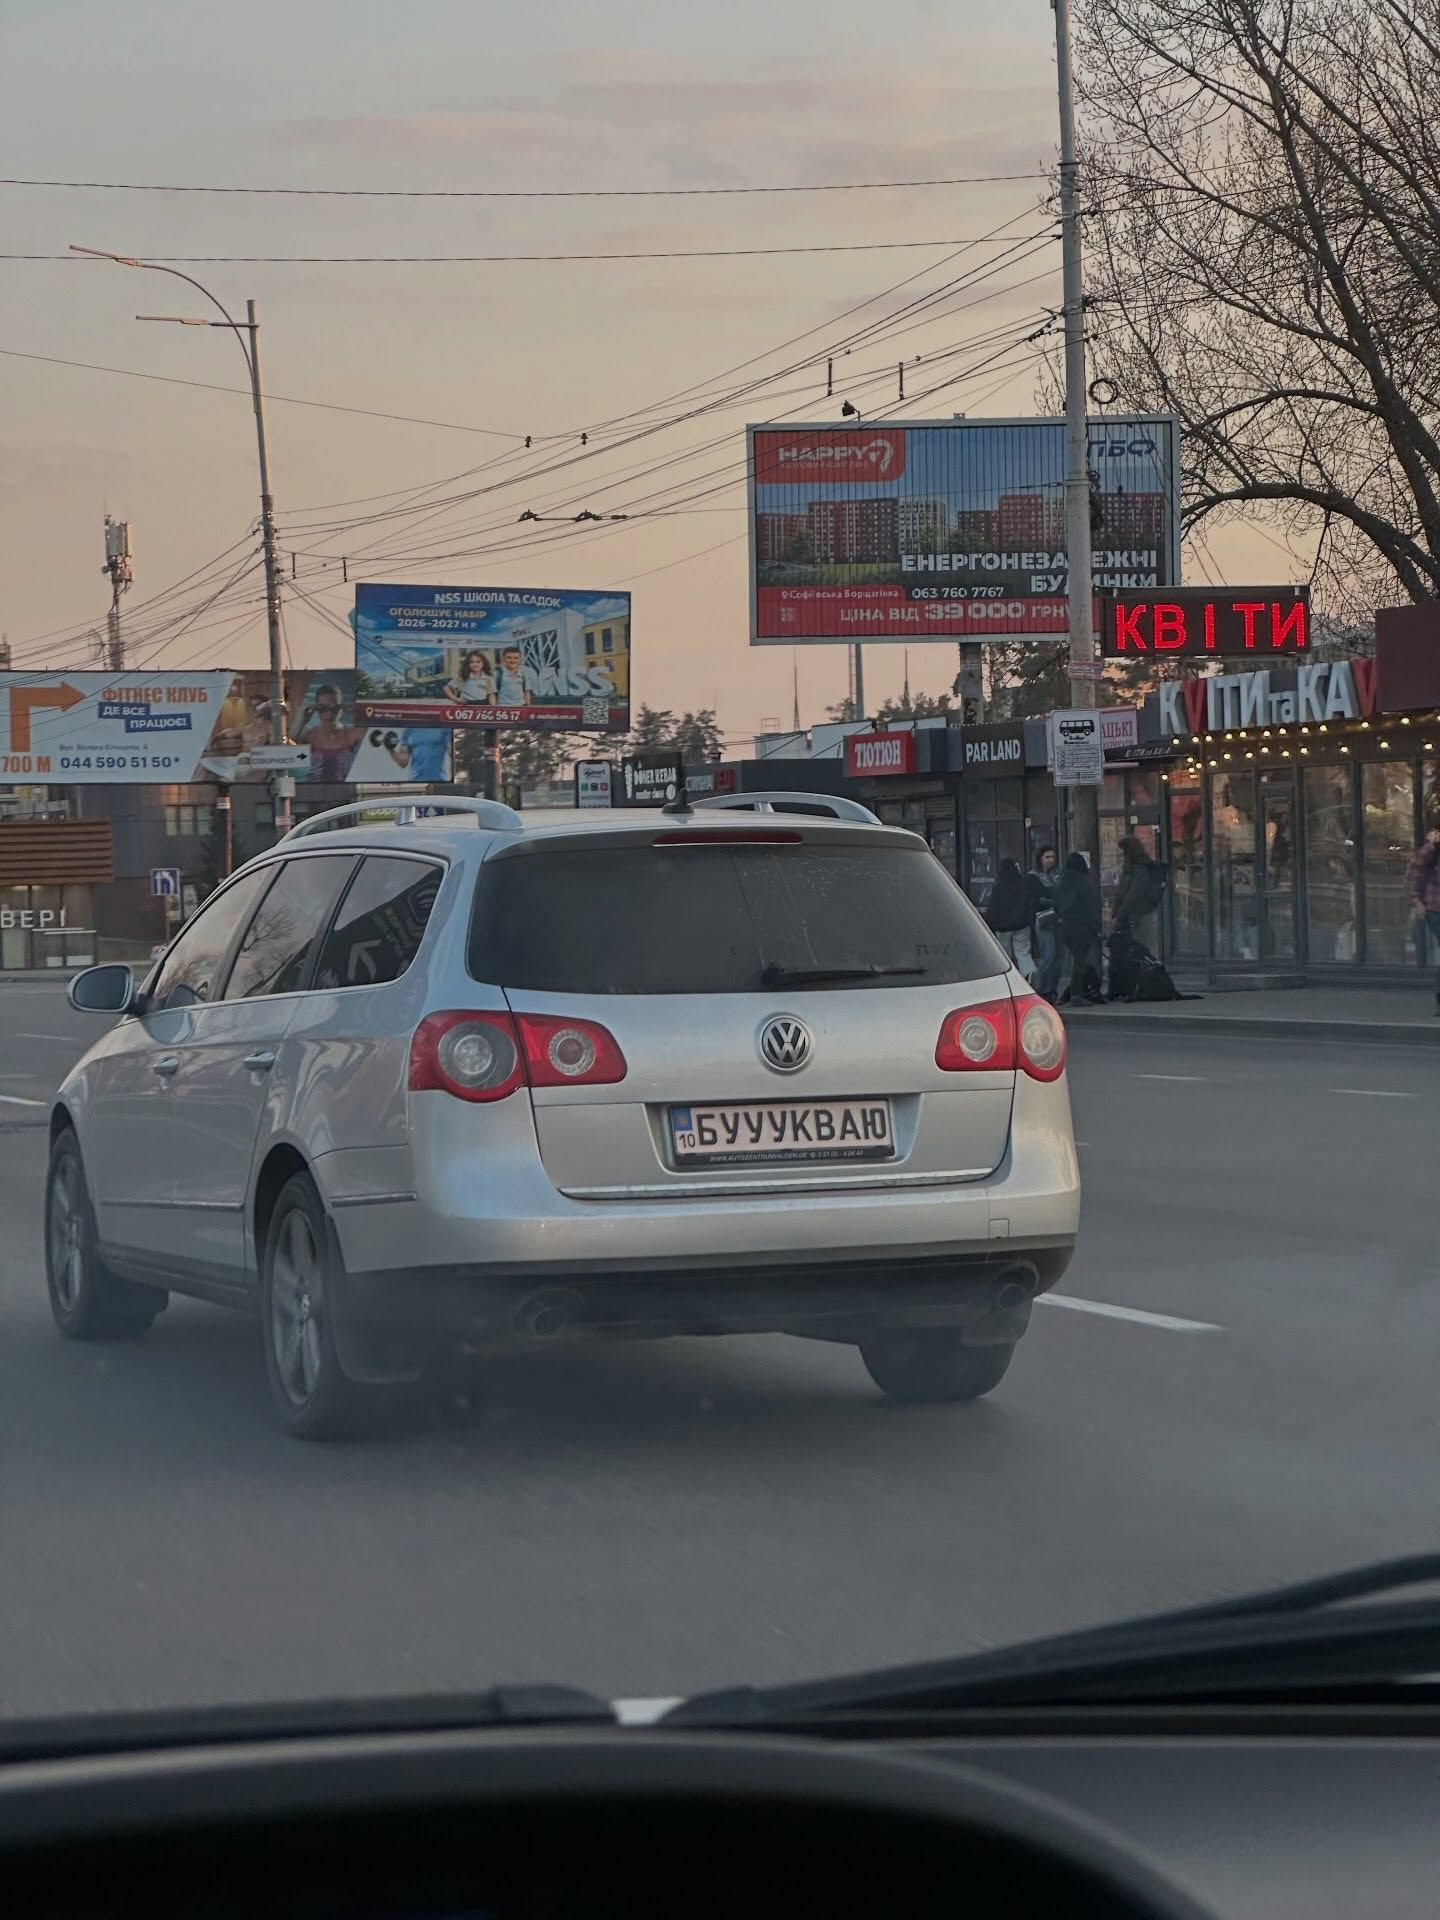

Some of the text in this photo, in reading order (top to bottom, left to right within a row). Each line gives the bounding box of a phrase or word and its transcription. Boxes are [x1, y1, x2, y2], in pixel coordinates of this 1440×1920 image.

[779, 446, 869, 461] HAPPY
[901, 551, 1157, 572] ЕНЕРГОНЕЗАЕЖНІ
[1031, 573, 1157, 593] БУНКИ
[434, 593, 560, 607] NSS ШКОЛА ТА САДОК
[912, 586, 1004, 598] 063 760 7767
[389, 608, 486, 618] ОГОЛОШУЄ НАБІР
[840, 608, 884, 622] ЦІНА
[889, 608, 919, 622] ВІД
[925, 603, 964, 619] 39
[967, 602, 1025, 619] 000
[1115, 602, 1305, 650] КВІТИ
[103, 687, 208, 703] ФІТНЕС КЛУБ
[103, 705, 146, 716] ДЕ ВСЕ
[130, 718, 187, 729] ПРАЦЮЄ!
[854, 739, 902, 768] ТЮТЮН
[966, 739, 1021, 763] PAR LAND
[3, 756, 51, 773] 700 М
[61, 757, 91, 768] 044
[96, 757, 126, 768] 590
[130, 757, 147, 768] 51
[679, 1108, 887, 1149] 10 БУУУКВАЮ
